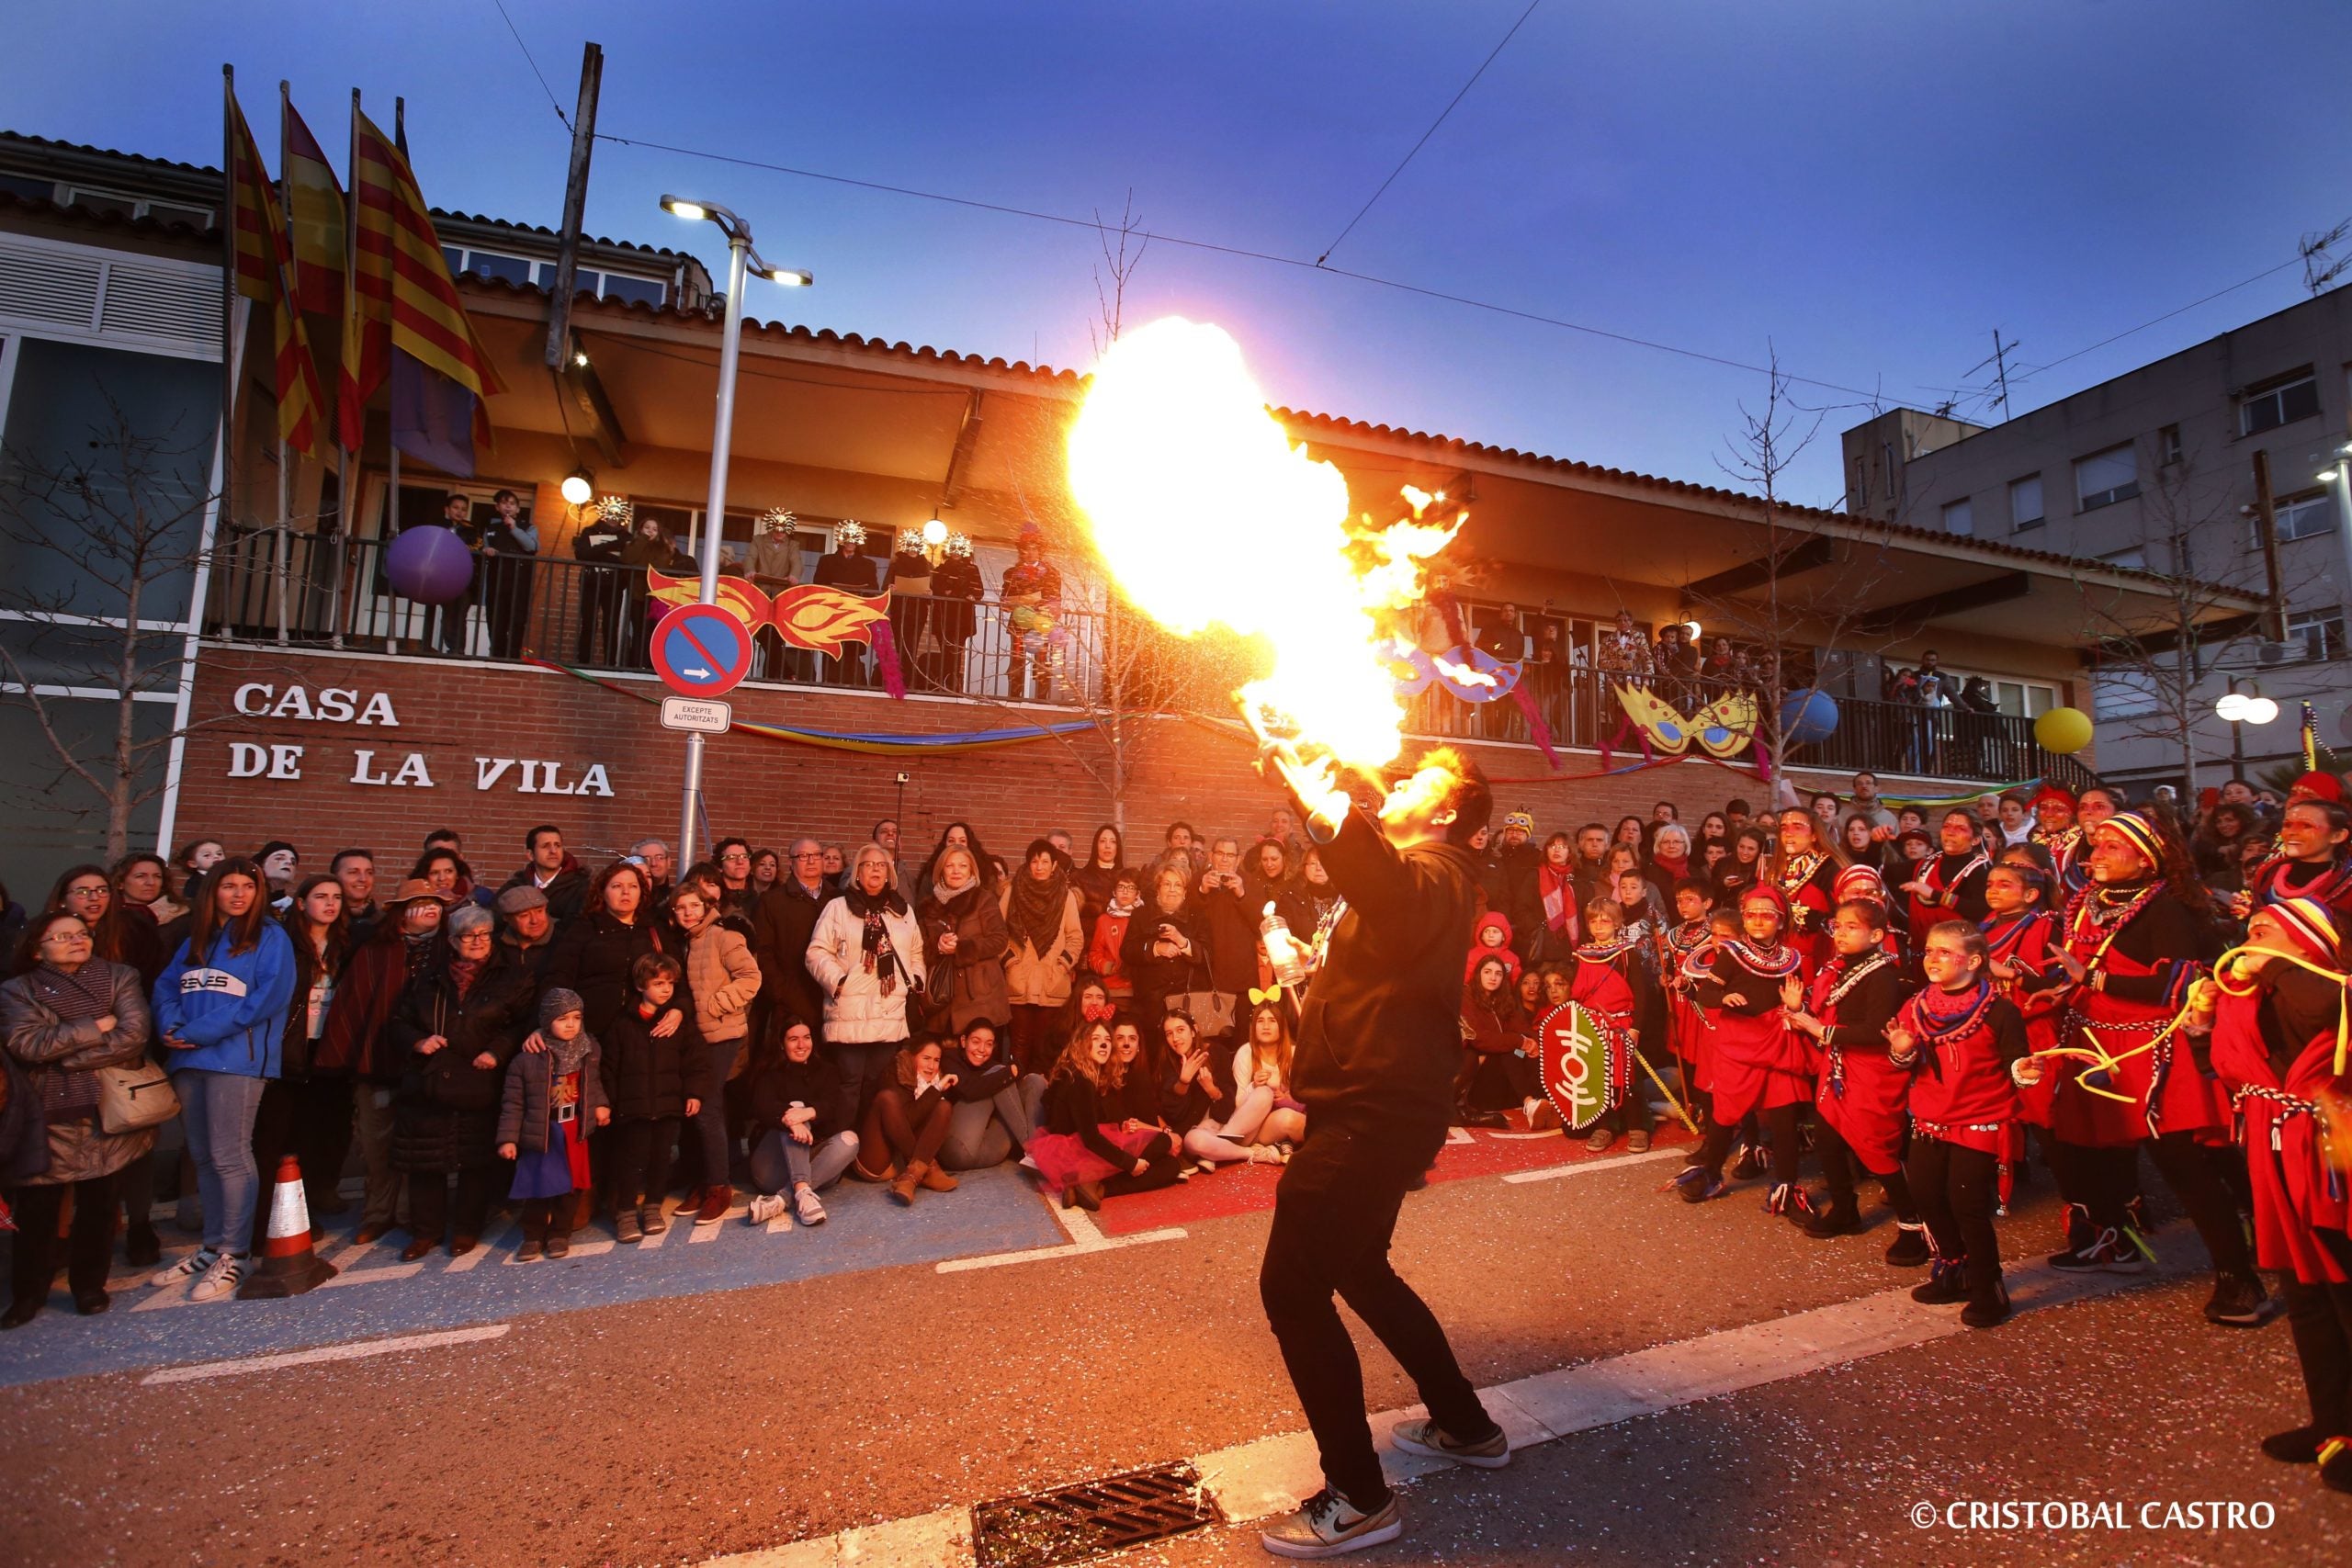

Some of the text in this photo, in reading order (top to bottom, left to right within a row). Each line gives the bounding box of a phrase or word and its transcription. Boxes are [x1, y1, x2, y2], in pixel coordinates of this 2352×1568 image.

[233, 682, 400, 726] CASA
[682, 706, 712, 715] EXCEPTE
[673, 714, 718, 724] AUTORITZATS
[227, 742, 615, 797] DE LA VILA
